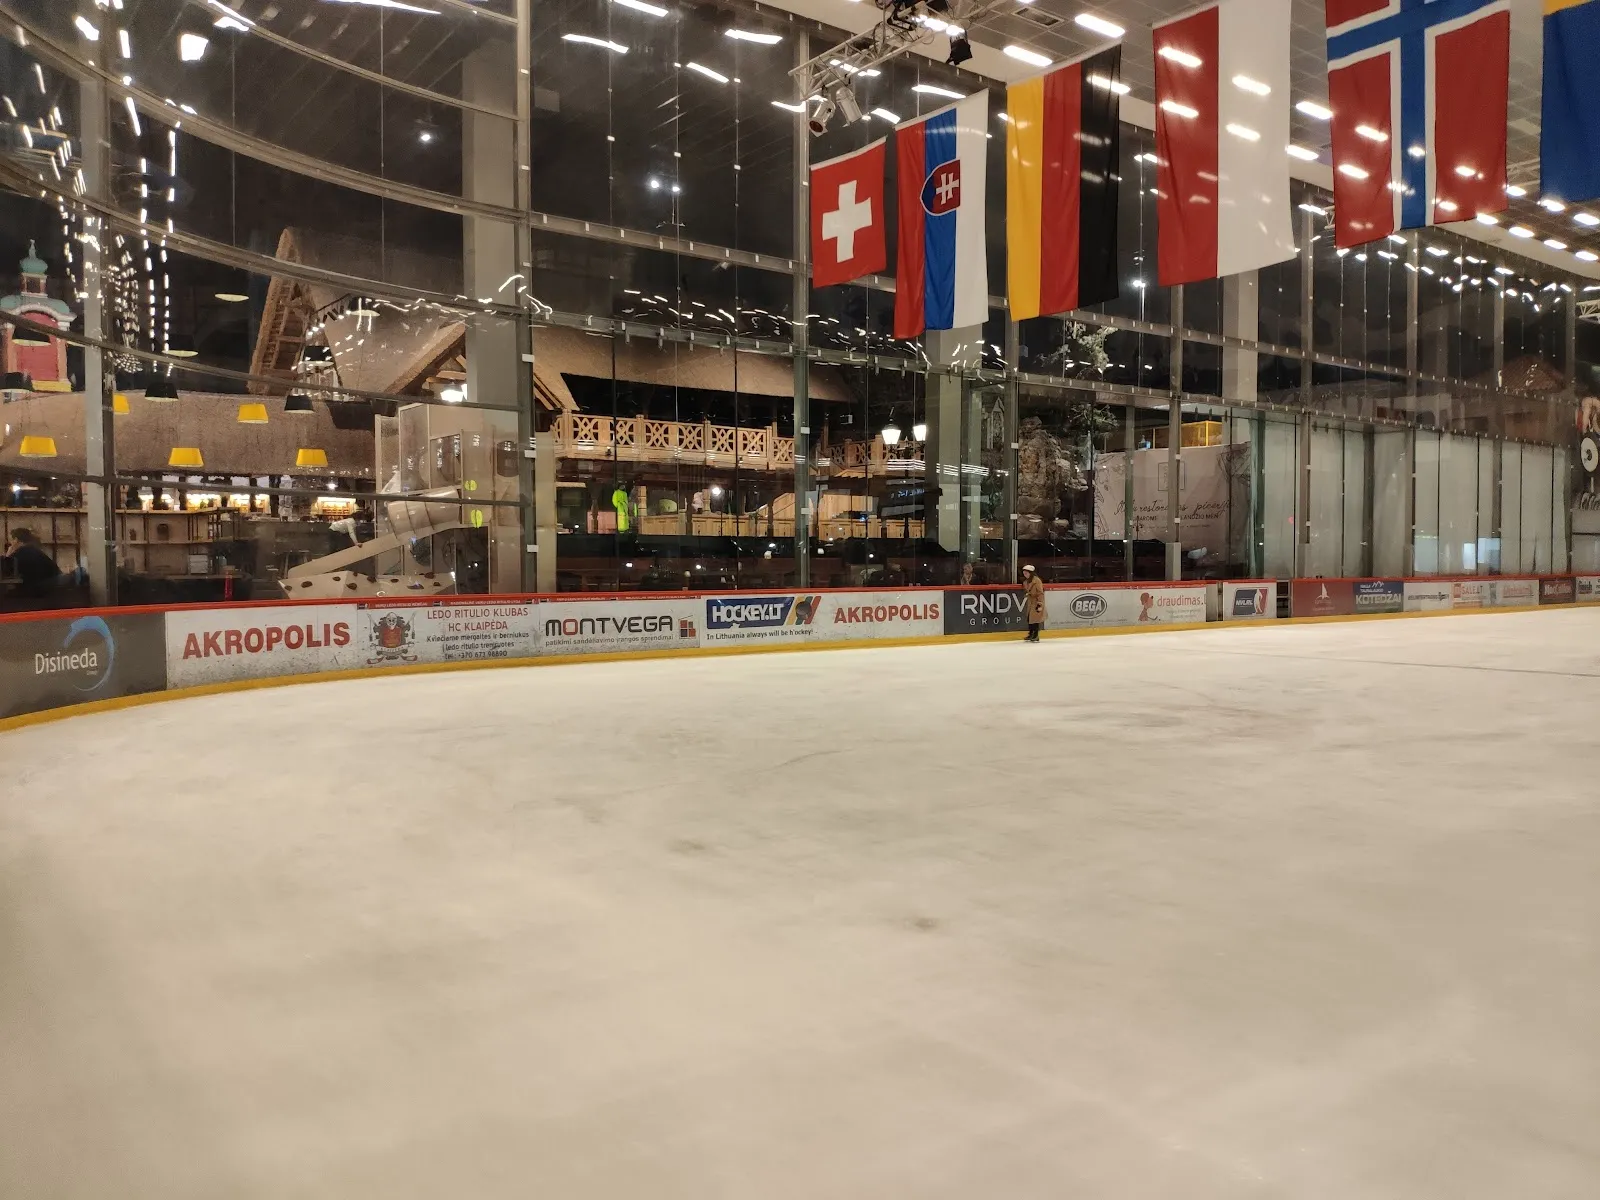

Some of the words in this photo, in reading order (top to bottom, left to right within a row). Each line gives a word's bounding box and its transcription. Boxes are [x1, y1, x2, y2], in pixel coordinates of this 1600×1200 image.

[1075, 599, 1102, 612] BEGA
[427, 609, 451, 620] LEDO
[454, 608, 490, 619] RITULIO
[493, 607, 529, 617] KLUBAS
[712, 603, 785, 622] HOCKEY.LT
[834, 603, 940, 624] AKROPOLIS
[448, 622, 460, 632] HC
[464, 619, 508, 632] KLAIPĖDA
[545, 615, 673, 636] MONTVEGA
[969, 617, 1022, 626] GROUP
[182, 622, 350, 660] AKROPOLIS
[499, 631, 530, 640] berniukus
[715, 632, 745, 640] Lithuania
[746, 630, 768, 638] always
[35, 648, 98, 675] Disineda
